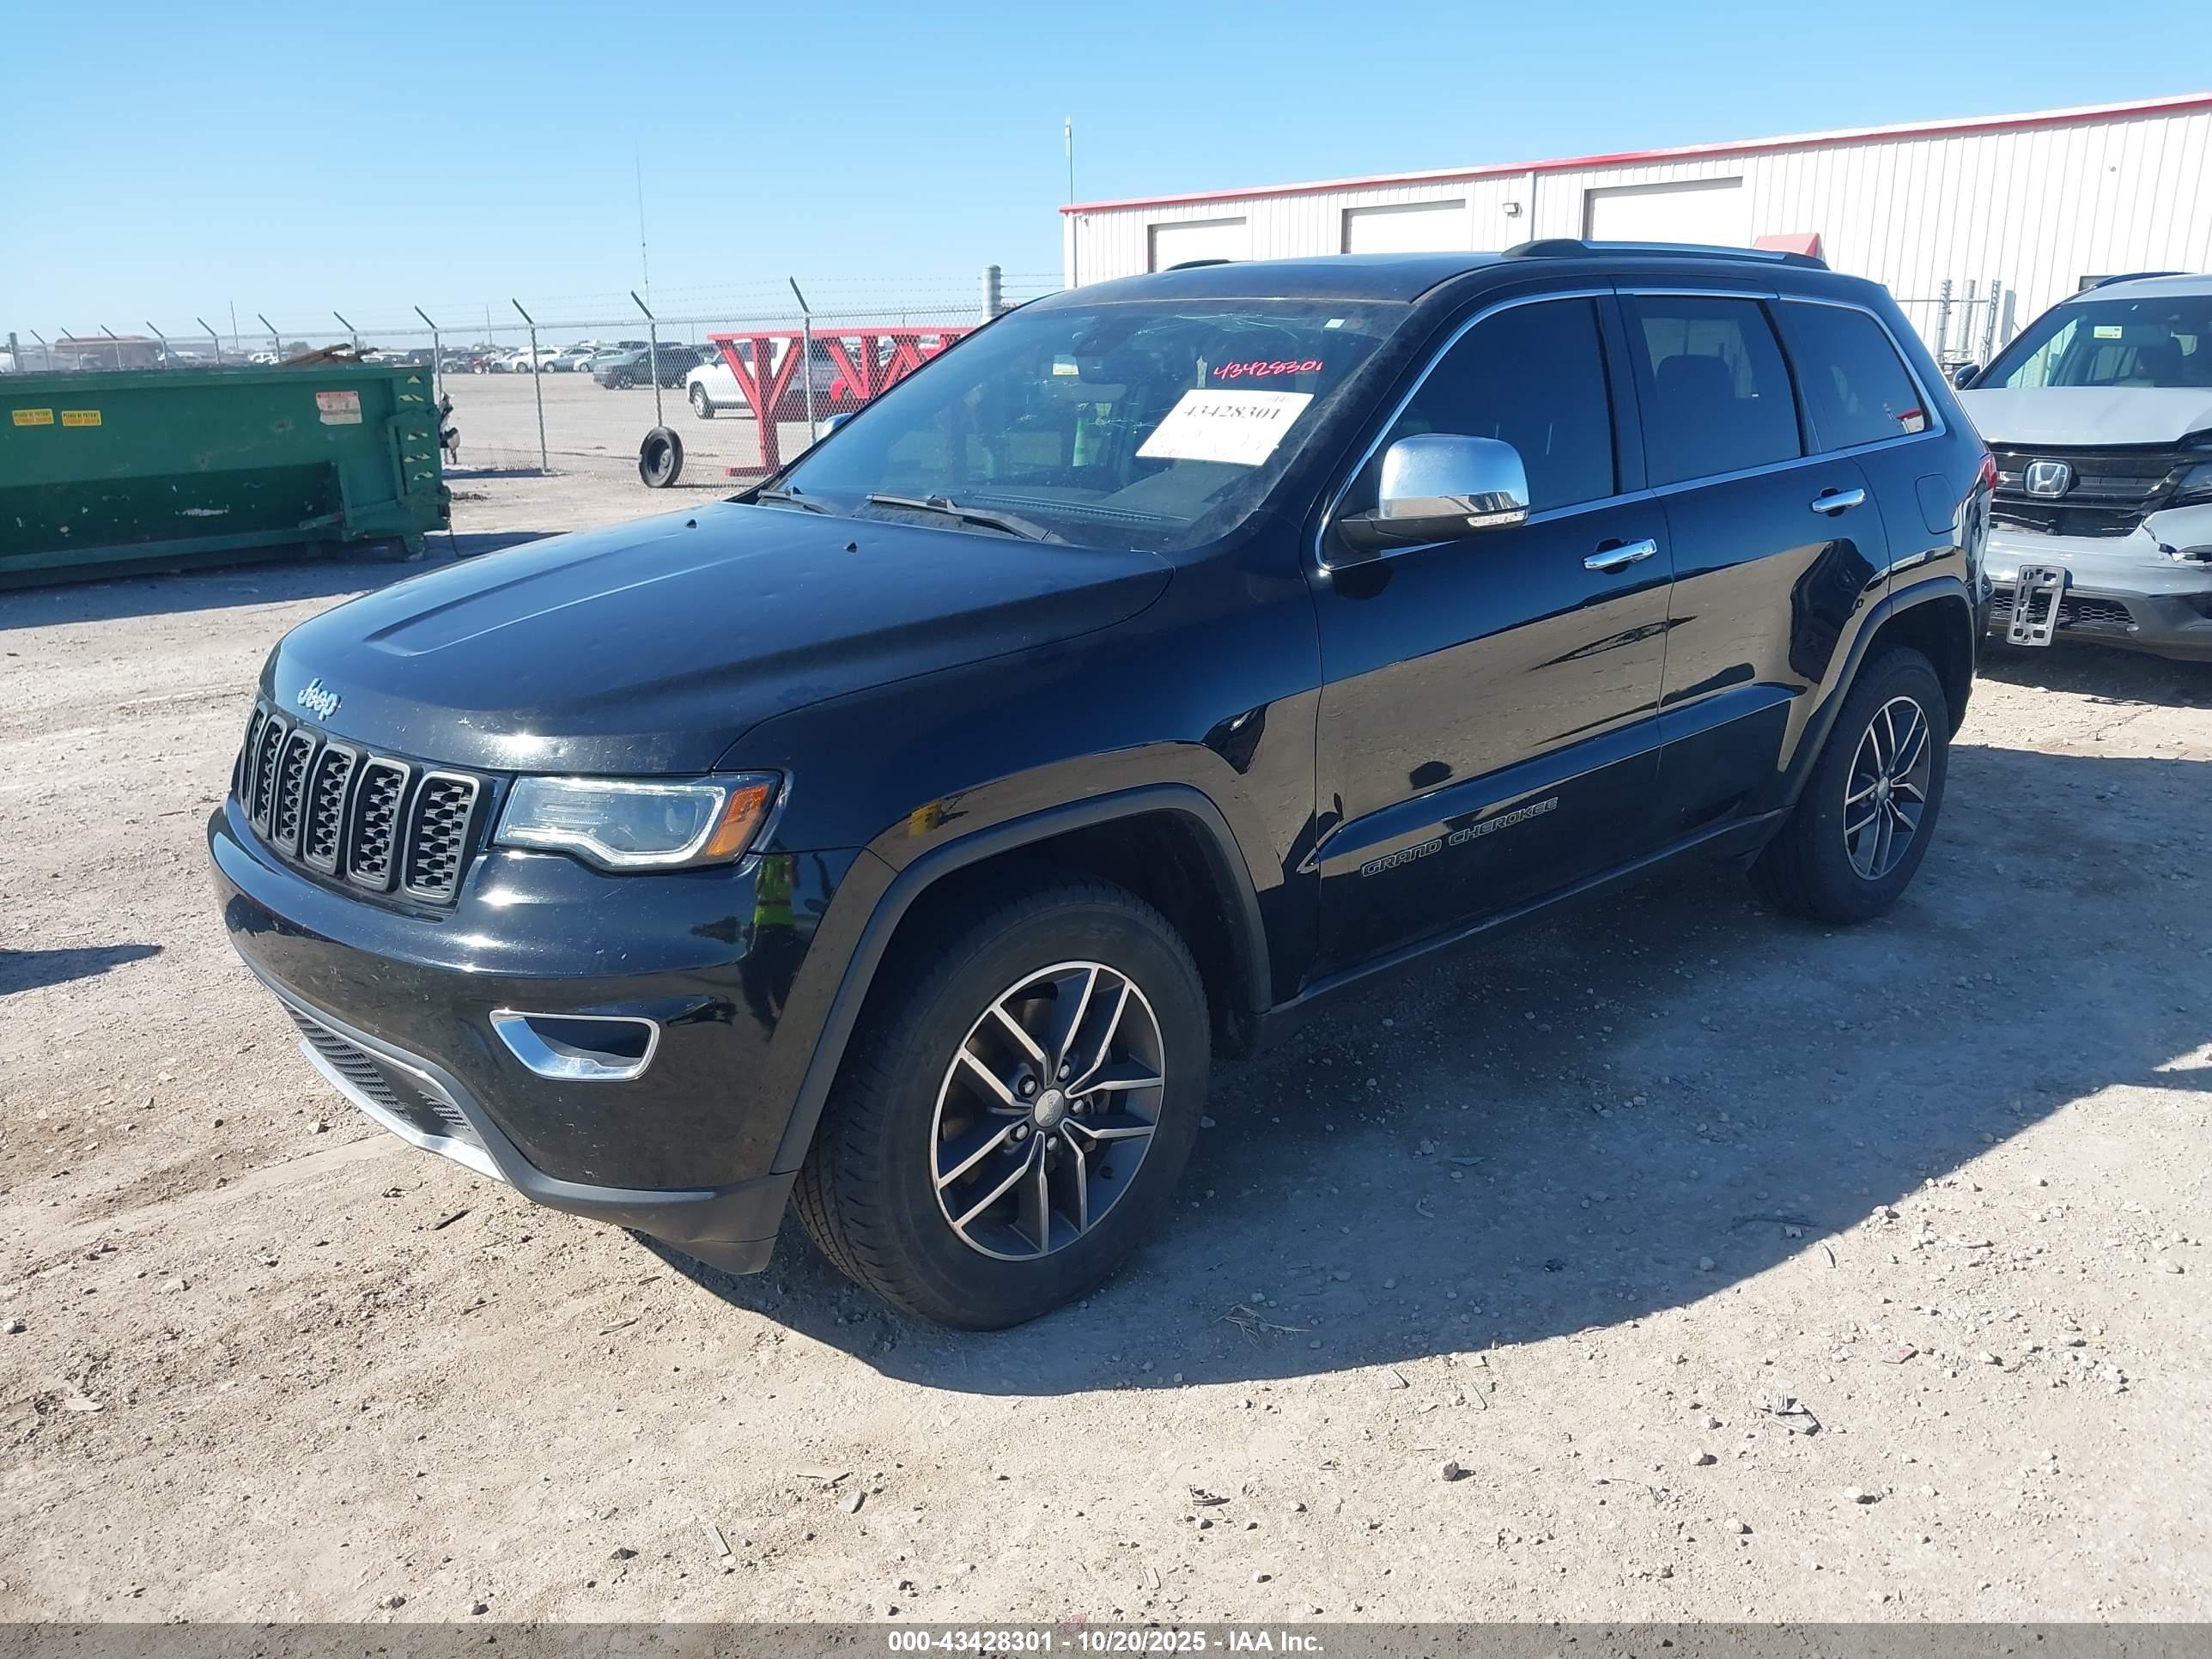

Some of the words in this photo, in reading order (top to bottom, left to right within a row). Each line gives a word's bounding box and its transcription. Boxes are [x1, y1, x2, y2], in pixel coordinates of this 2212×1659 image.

[1212, 360, 1323, 380] 43428301
[1183, 405, 1282, 420] 43428301
[297, 678, 341, 721] Jeep
[1361, 839, 1443, 878] GRAND
[1449, 797, 1559, 846] CHEROKEE
